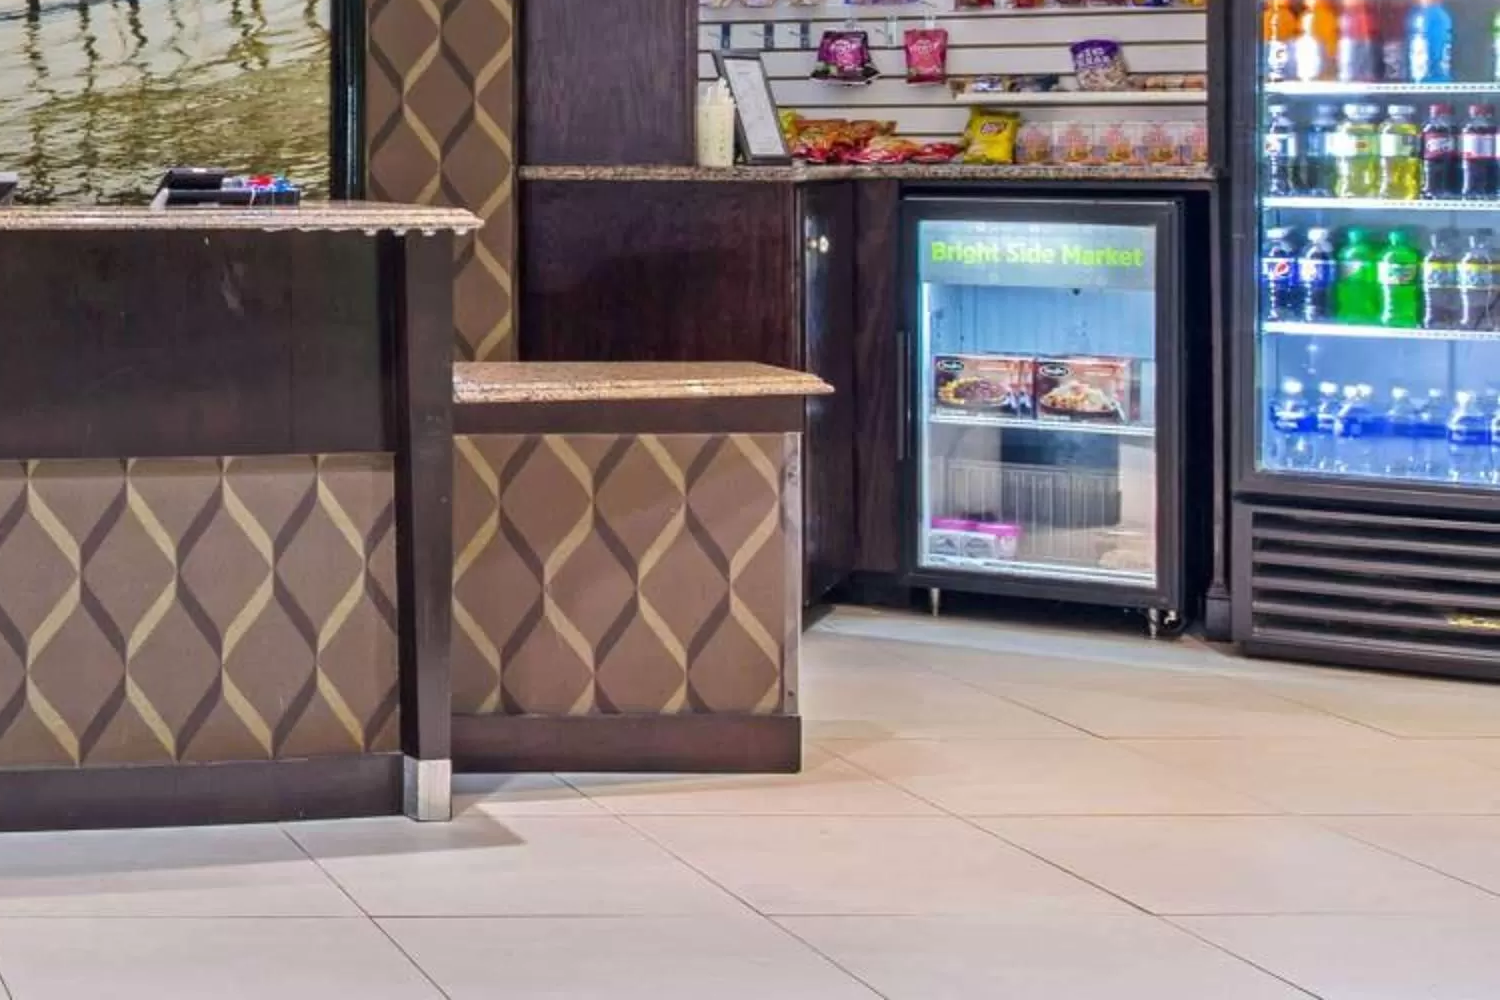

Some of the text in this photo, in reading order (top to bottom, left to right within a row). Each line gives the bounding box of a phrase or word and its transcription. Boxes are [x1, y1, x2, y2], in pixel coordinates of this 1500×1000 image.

[931, 241, 1144, 266] Bright Side Market
